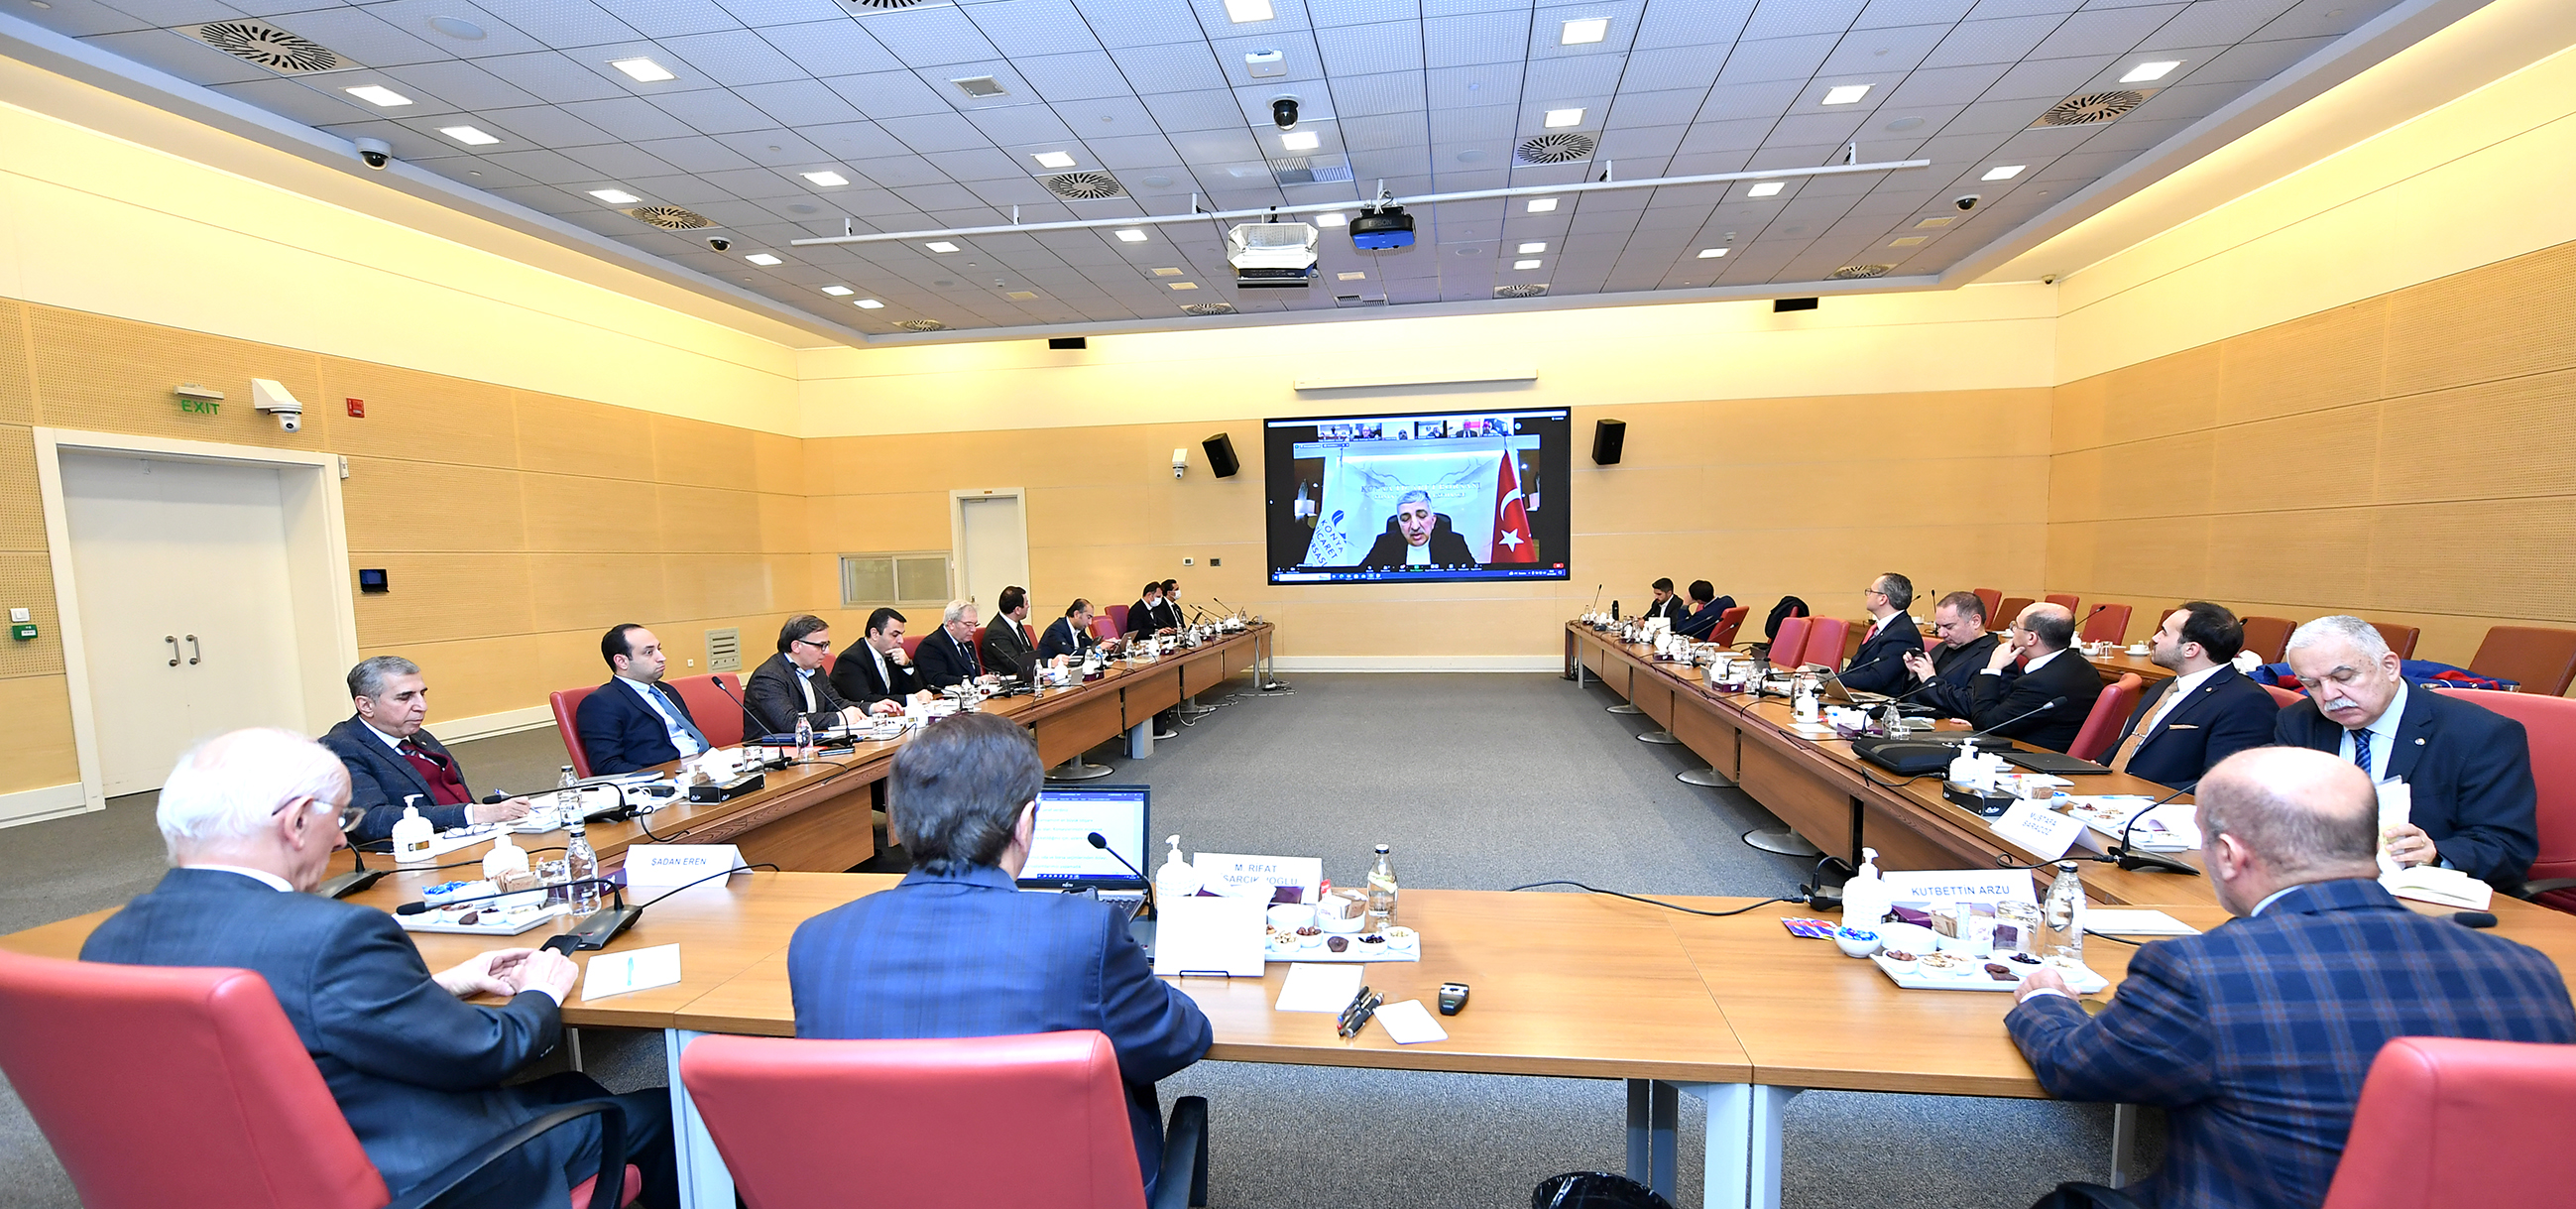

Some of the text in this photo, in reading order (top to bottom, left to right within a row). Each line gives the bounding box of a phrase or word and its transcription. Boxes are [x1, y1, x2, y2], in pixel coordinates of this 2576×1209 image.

[181, 399, 220, 415] EXIT
[1321, 519, 1344, 553] KONYA
[682, 857, 707, 866] EREN
[1979, 885, 2010, 895] ARZU
